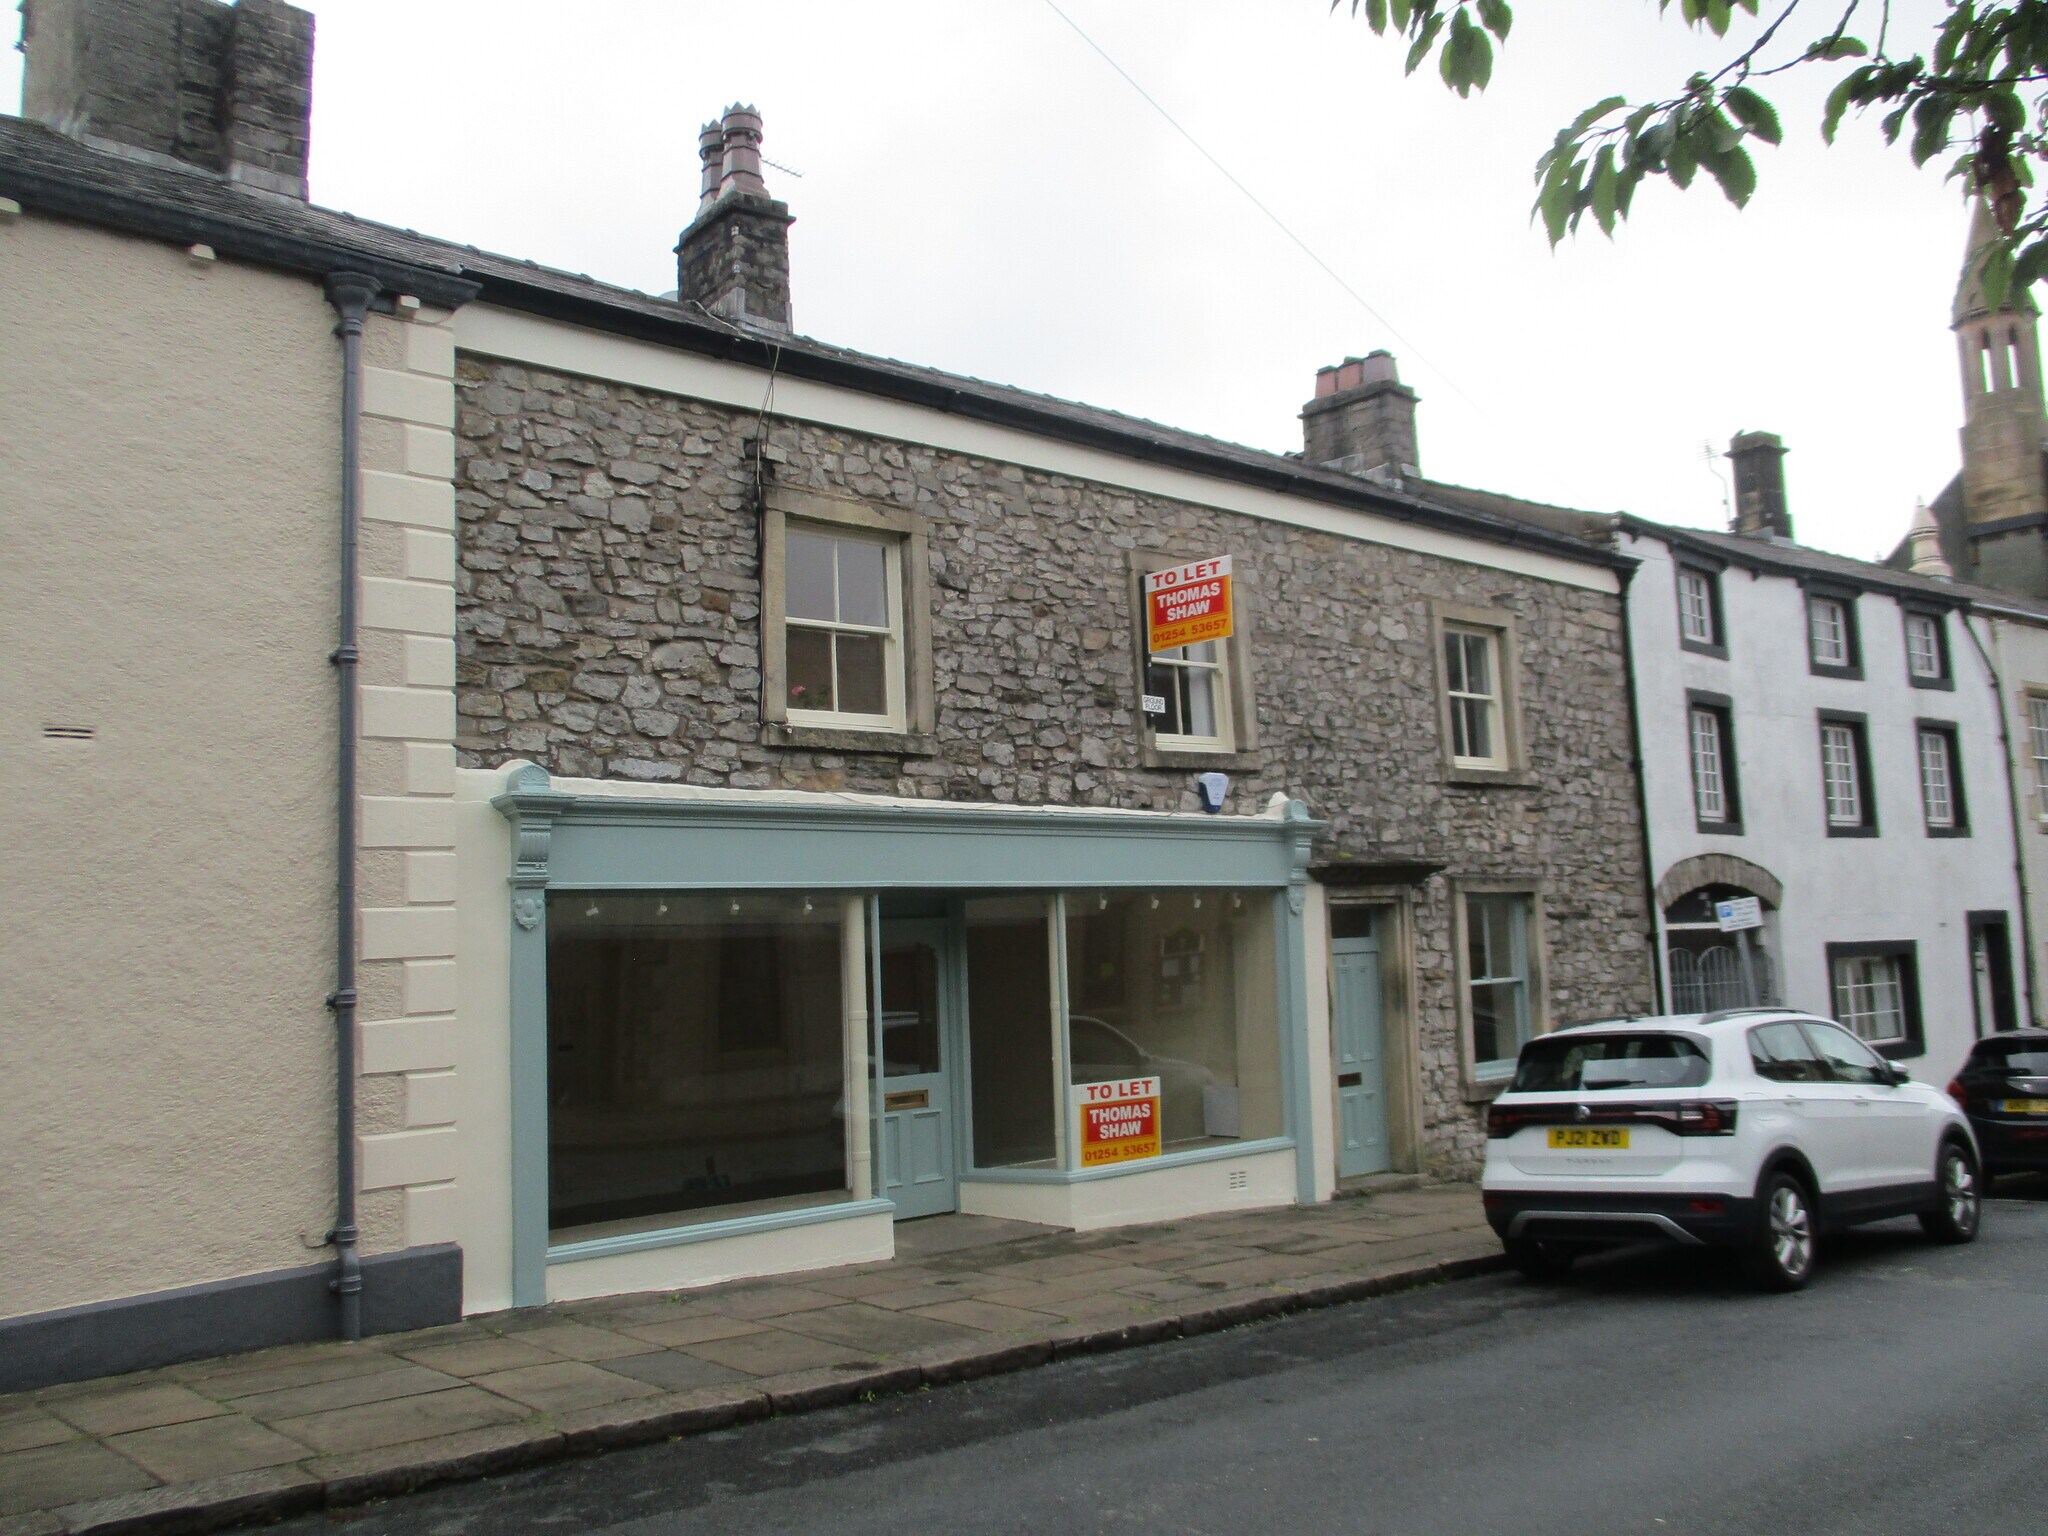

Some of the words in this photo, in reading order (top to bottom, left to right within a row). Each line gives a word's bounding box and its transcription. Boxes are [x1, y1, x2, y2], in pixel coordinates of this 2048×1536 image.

[1153, 571, 1177, 587] TO
[1184, 561, 1221, 580] LET
[1157, 582, 1220, 608] THOMAS
[1167, 600, 1210, 621] SHAW
[1153, 627, 1186, 643] 01254
[1192, 618, 1228, 634] 53657
[1087, 1085, 1112, 1100] TO
[1119, 1080, 1152, 1097] LET
[1089, 1103, 1151, 1124] THOMAS
[1099, 1120, 1142, 1139] SHAW
[1085, 1148, 1118, 1161] 01254
[1124, 1142, 1156, 1156] 53657
